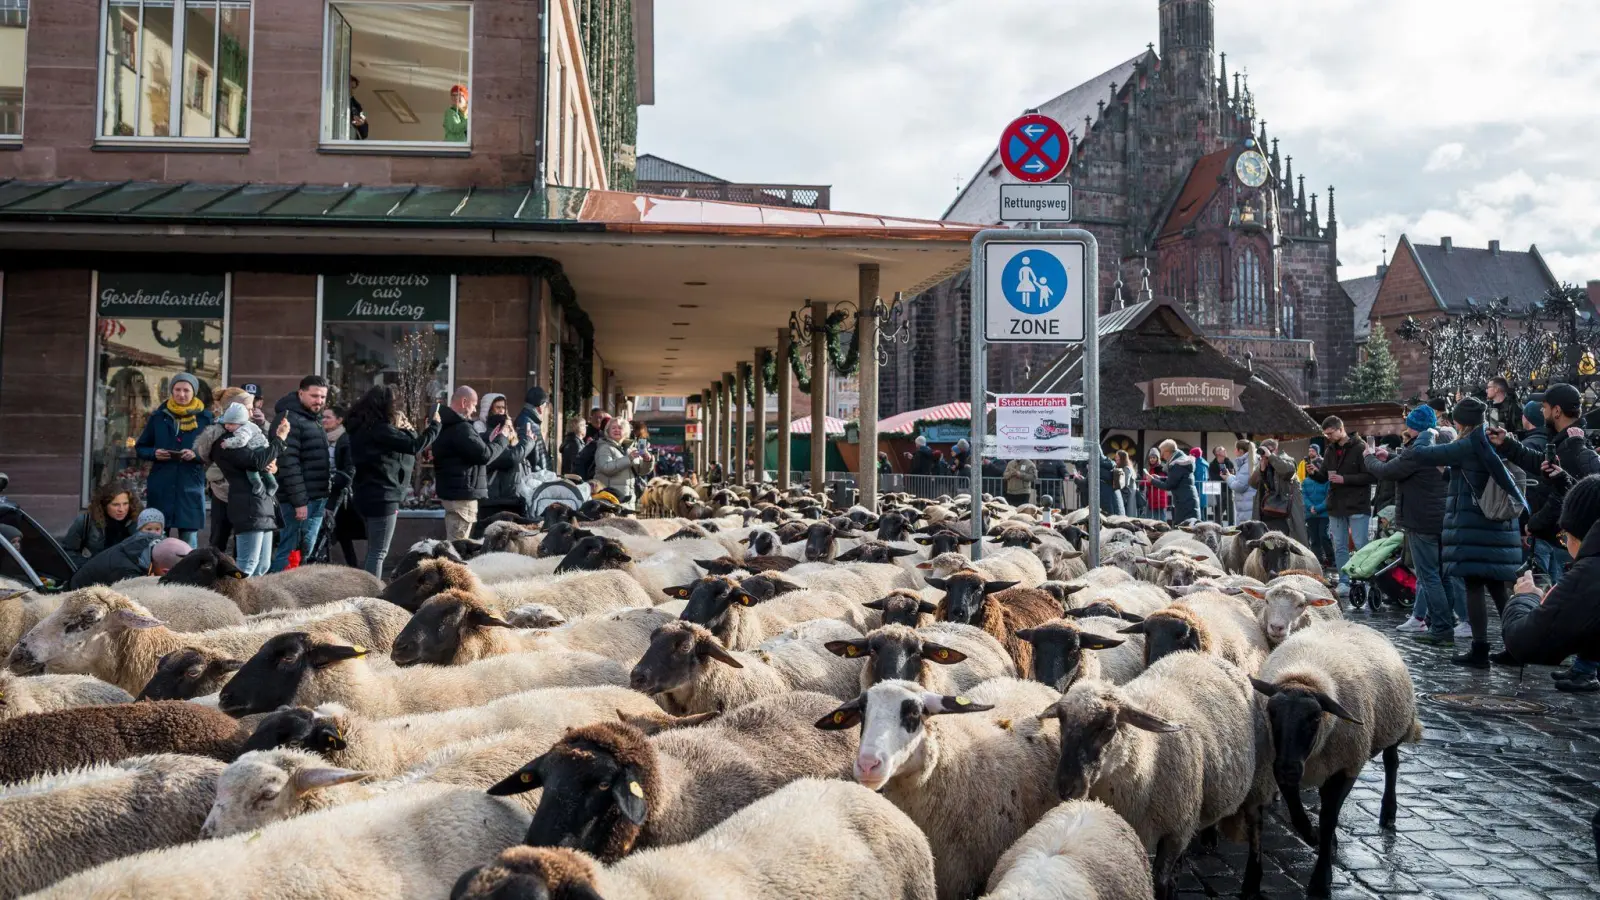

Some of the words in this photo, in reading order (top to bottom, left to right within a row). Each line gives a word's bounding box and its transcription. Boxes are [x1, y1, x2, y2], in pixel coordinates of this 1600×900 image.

[1004, 197, 1067, 211] Rettungsweg
[346, 272, 429, 286] Souvenirs
[101, 288, 223, 308] Geschenkartikel
[372, 287, 402, 298] aus
[347, 299, 425, 319] Nürnberg
[1010, 319, 1059, 334] ZONE
[1001, 398, 1064, 406] Stadtrundfahrt
